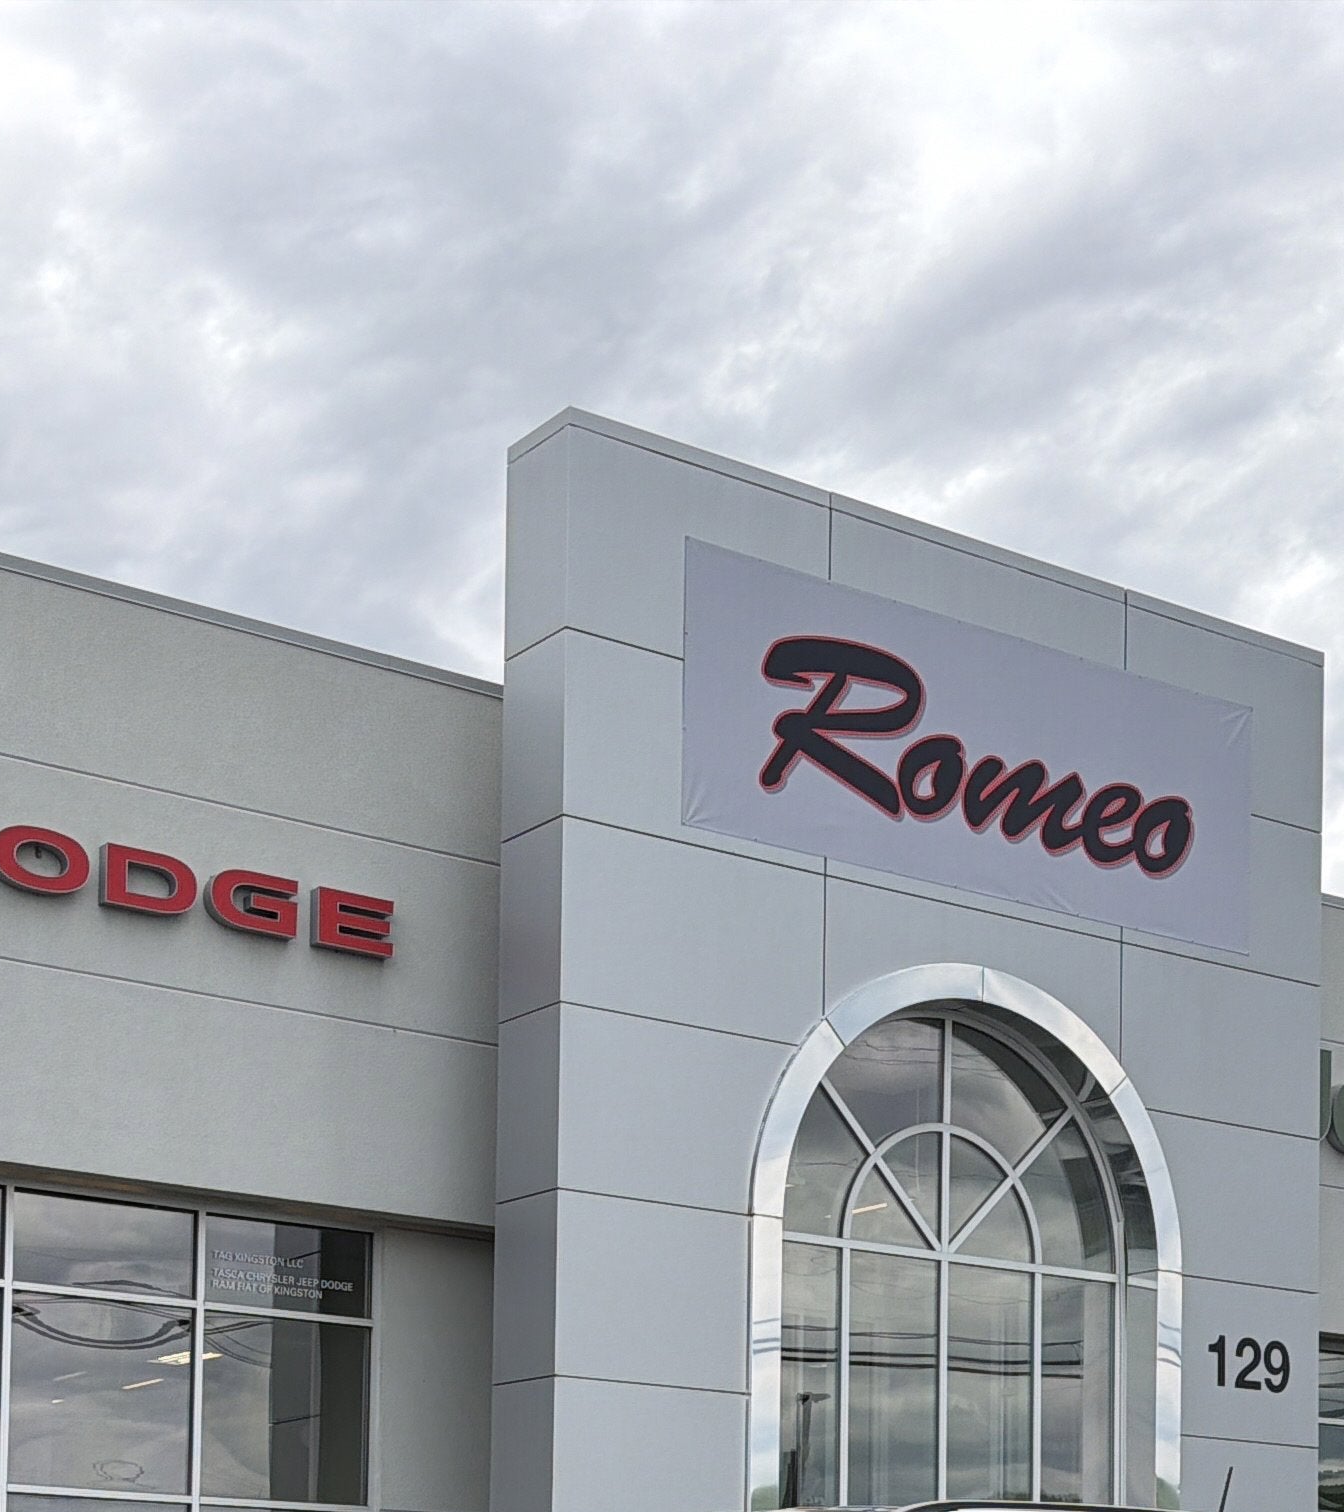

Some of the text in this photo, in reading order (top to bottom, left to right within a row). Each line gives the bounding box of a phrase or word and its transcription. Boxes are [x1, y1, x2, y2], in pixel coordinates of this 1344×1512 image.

[759, 635, 1193, 879] Romeo
[234, 1252, 285, 1267] KINGSTON
[286, 1258, 304, 1269] LLC
[212, 1268, 354, 1292] TASCA CHRYSLER JEEP DODGE
[212, 1279, 235, 1291] RAM
[258, 1283, 273, 1294] OF
[274, 1286, 323, 1299] KINGSTON
[1208, 1334, 1290, 1394] 129
